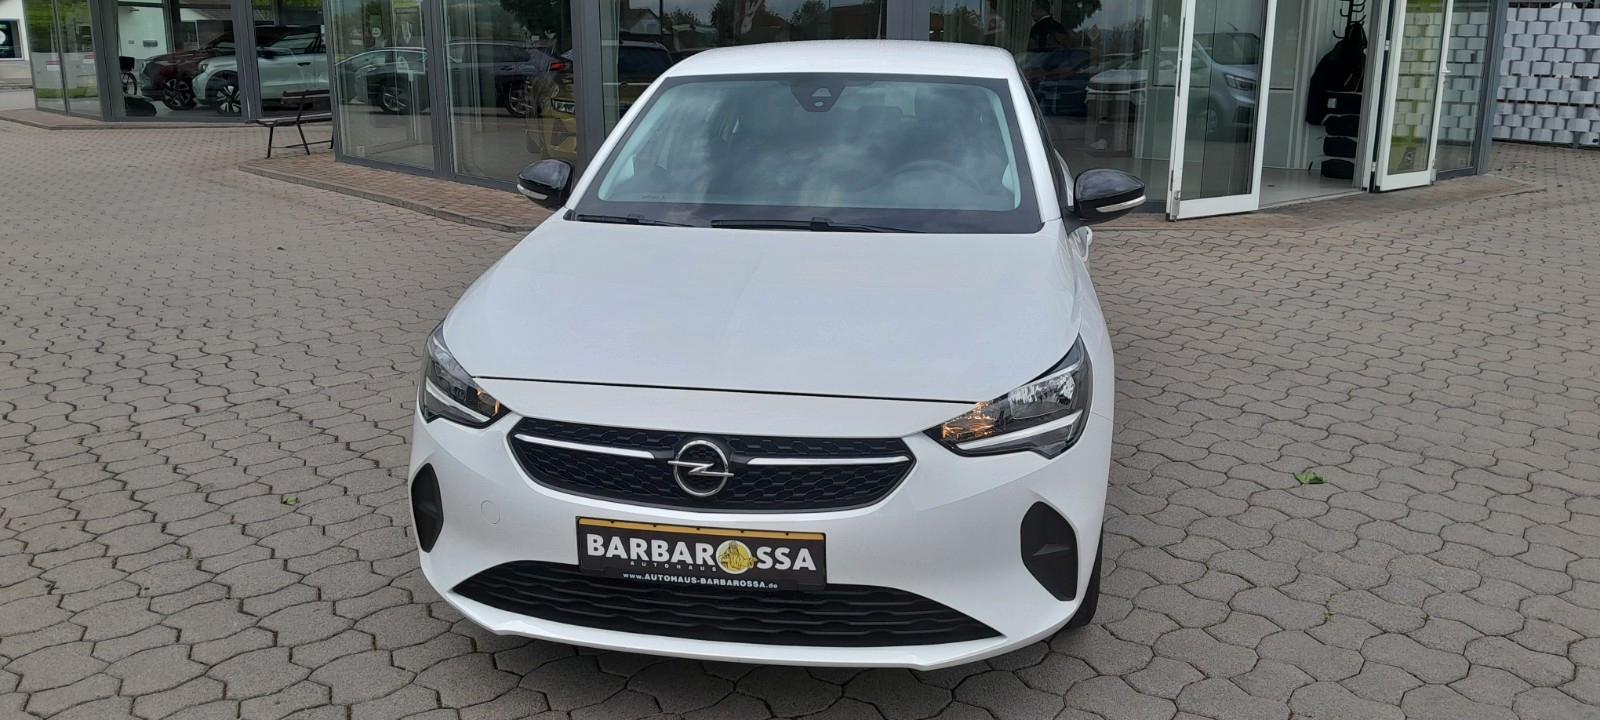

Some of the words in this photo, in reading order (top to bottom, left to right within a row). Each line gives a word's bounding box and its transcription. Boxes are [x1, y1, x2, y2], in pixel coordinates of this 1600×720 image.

[586, 533, 817, 574] BARBAROSSA
[630, 560, 717, 572] AUTOHAUS
[623, 572, 778, 589] www.AUTOHAUS-BARBAROSSA.de
